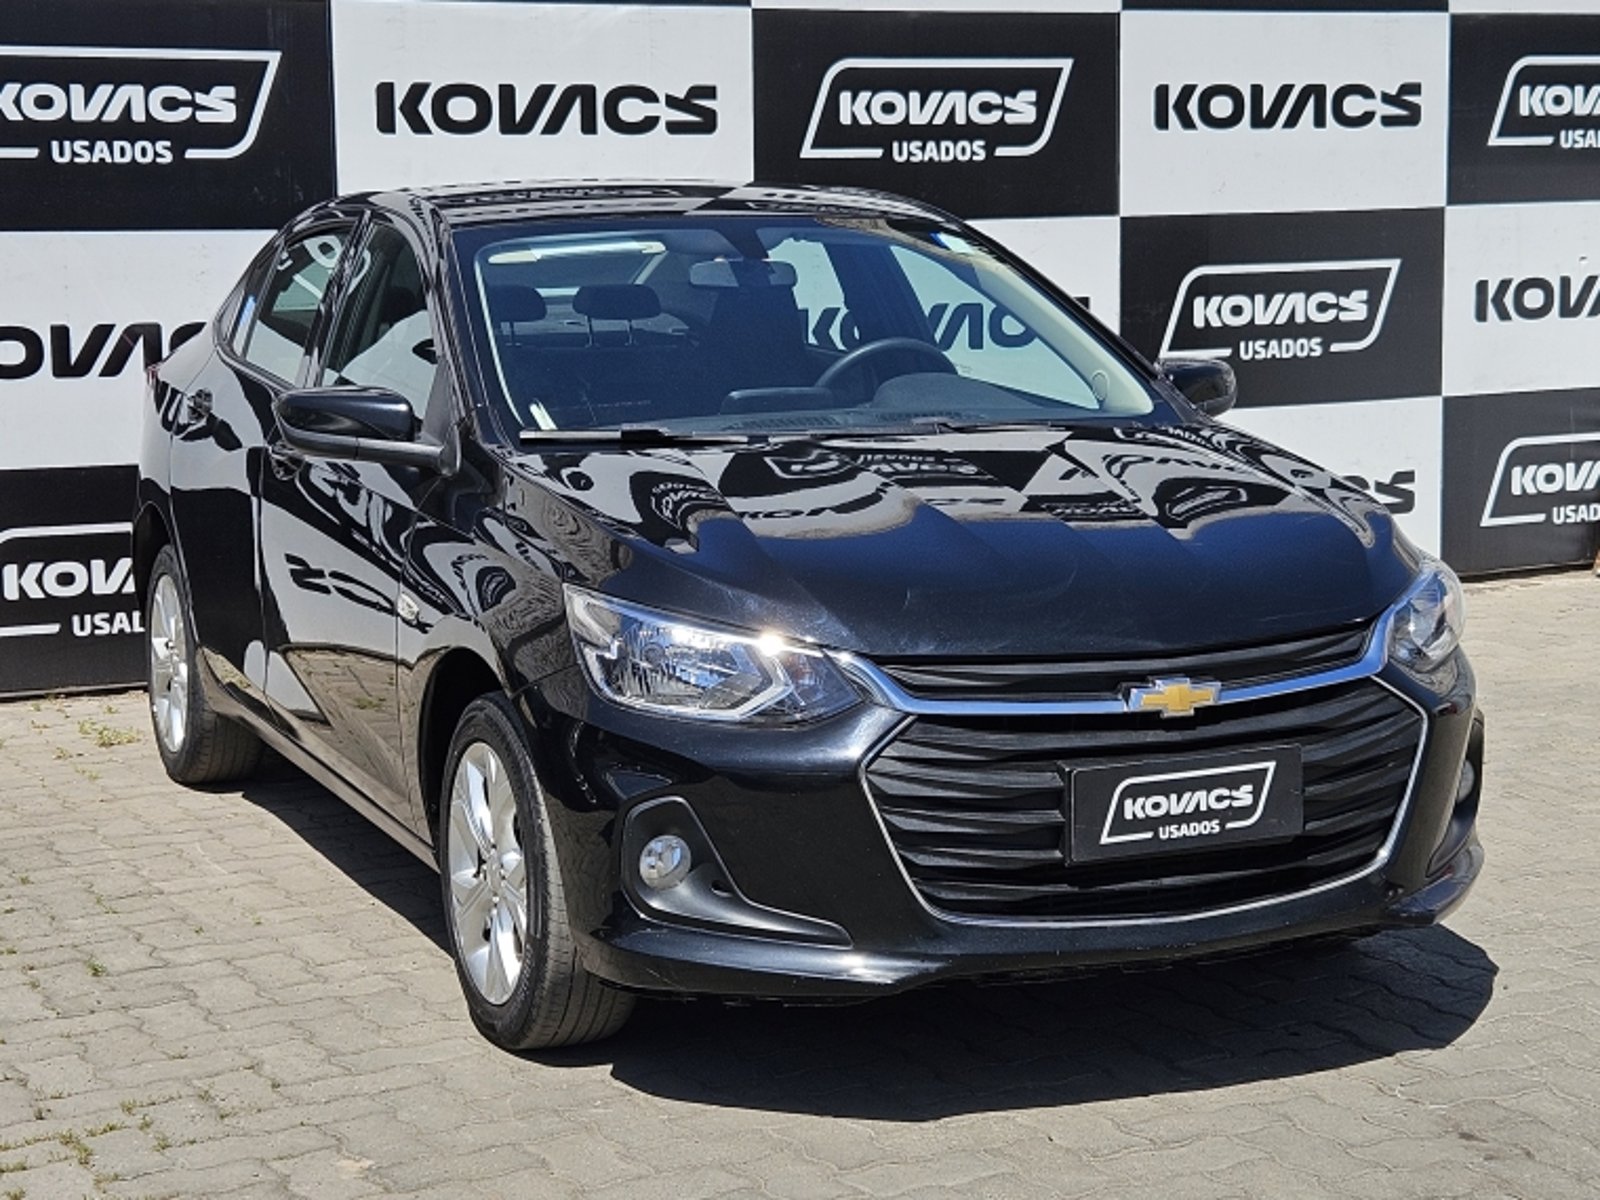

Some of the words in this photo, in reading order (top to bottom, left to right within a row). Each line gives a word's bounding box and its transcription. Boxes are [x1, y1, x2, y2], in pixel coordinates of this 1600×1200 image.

[375, 81, 718, 136] KOVACS
[838, 90, 1038, 126] KOVACS
[1154, 82, 1422, 131] KOVACS
[1519, 85, 1600, 117] KOV
[51, 140, 174, 164] USADOS
[892, 140, 986, 163] USADOS
[1559, 129, 1600, 149] USA
[1193, 289, 1369, 328] KOVACS
[1474, 275, 1600, 323] KOV
[1239, 336, 1323, 361] USADOS
[1123, 784, 1253, 819] KOVACS
[1158, 819, 1221, 840] USADOS
